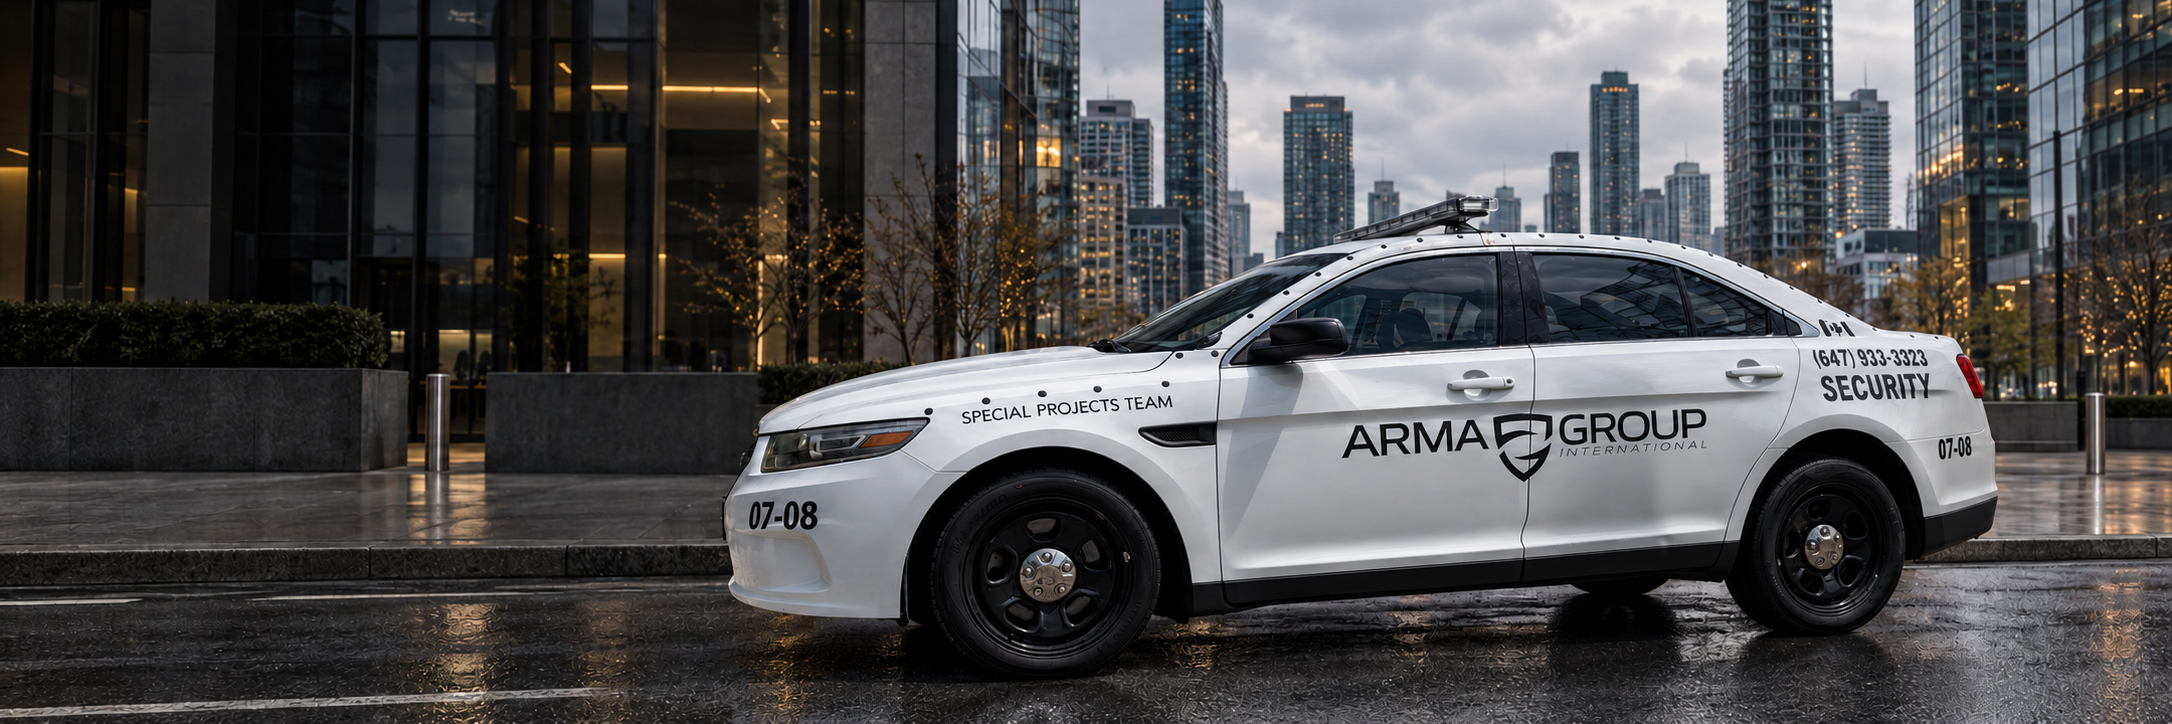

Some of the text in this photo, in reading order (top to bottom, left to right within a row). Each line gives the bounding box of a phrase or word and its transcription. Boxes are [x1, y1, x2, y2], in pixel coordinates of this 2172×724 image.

[1812, 349, 1928, 369] (647) 933-3323
[1820, 373, 1929, 402] SECURITY
[961, 395, 1173, 424] SPECIAL PROJECTS TEAM
[1342, 408, 1707, 458] ARMA GROUP
[1559, 440, 1708, 458] INTERNATIONAL
[1938, 436, 1972, 460] 07-08
[749, 501, 818, 530] 07-08
